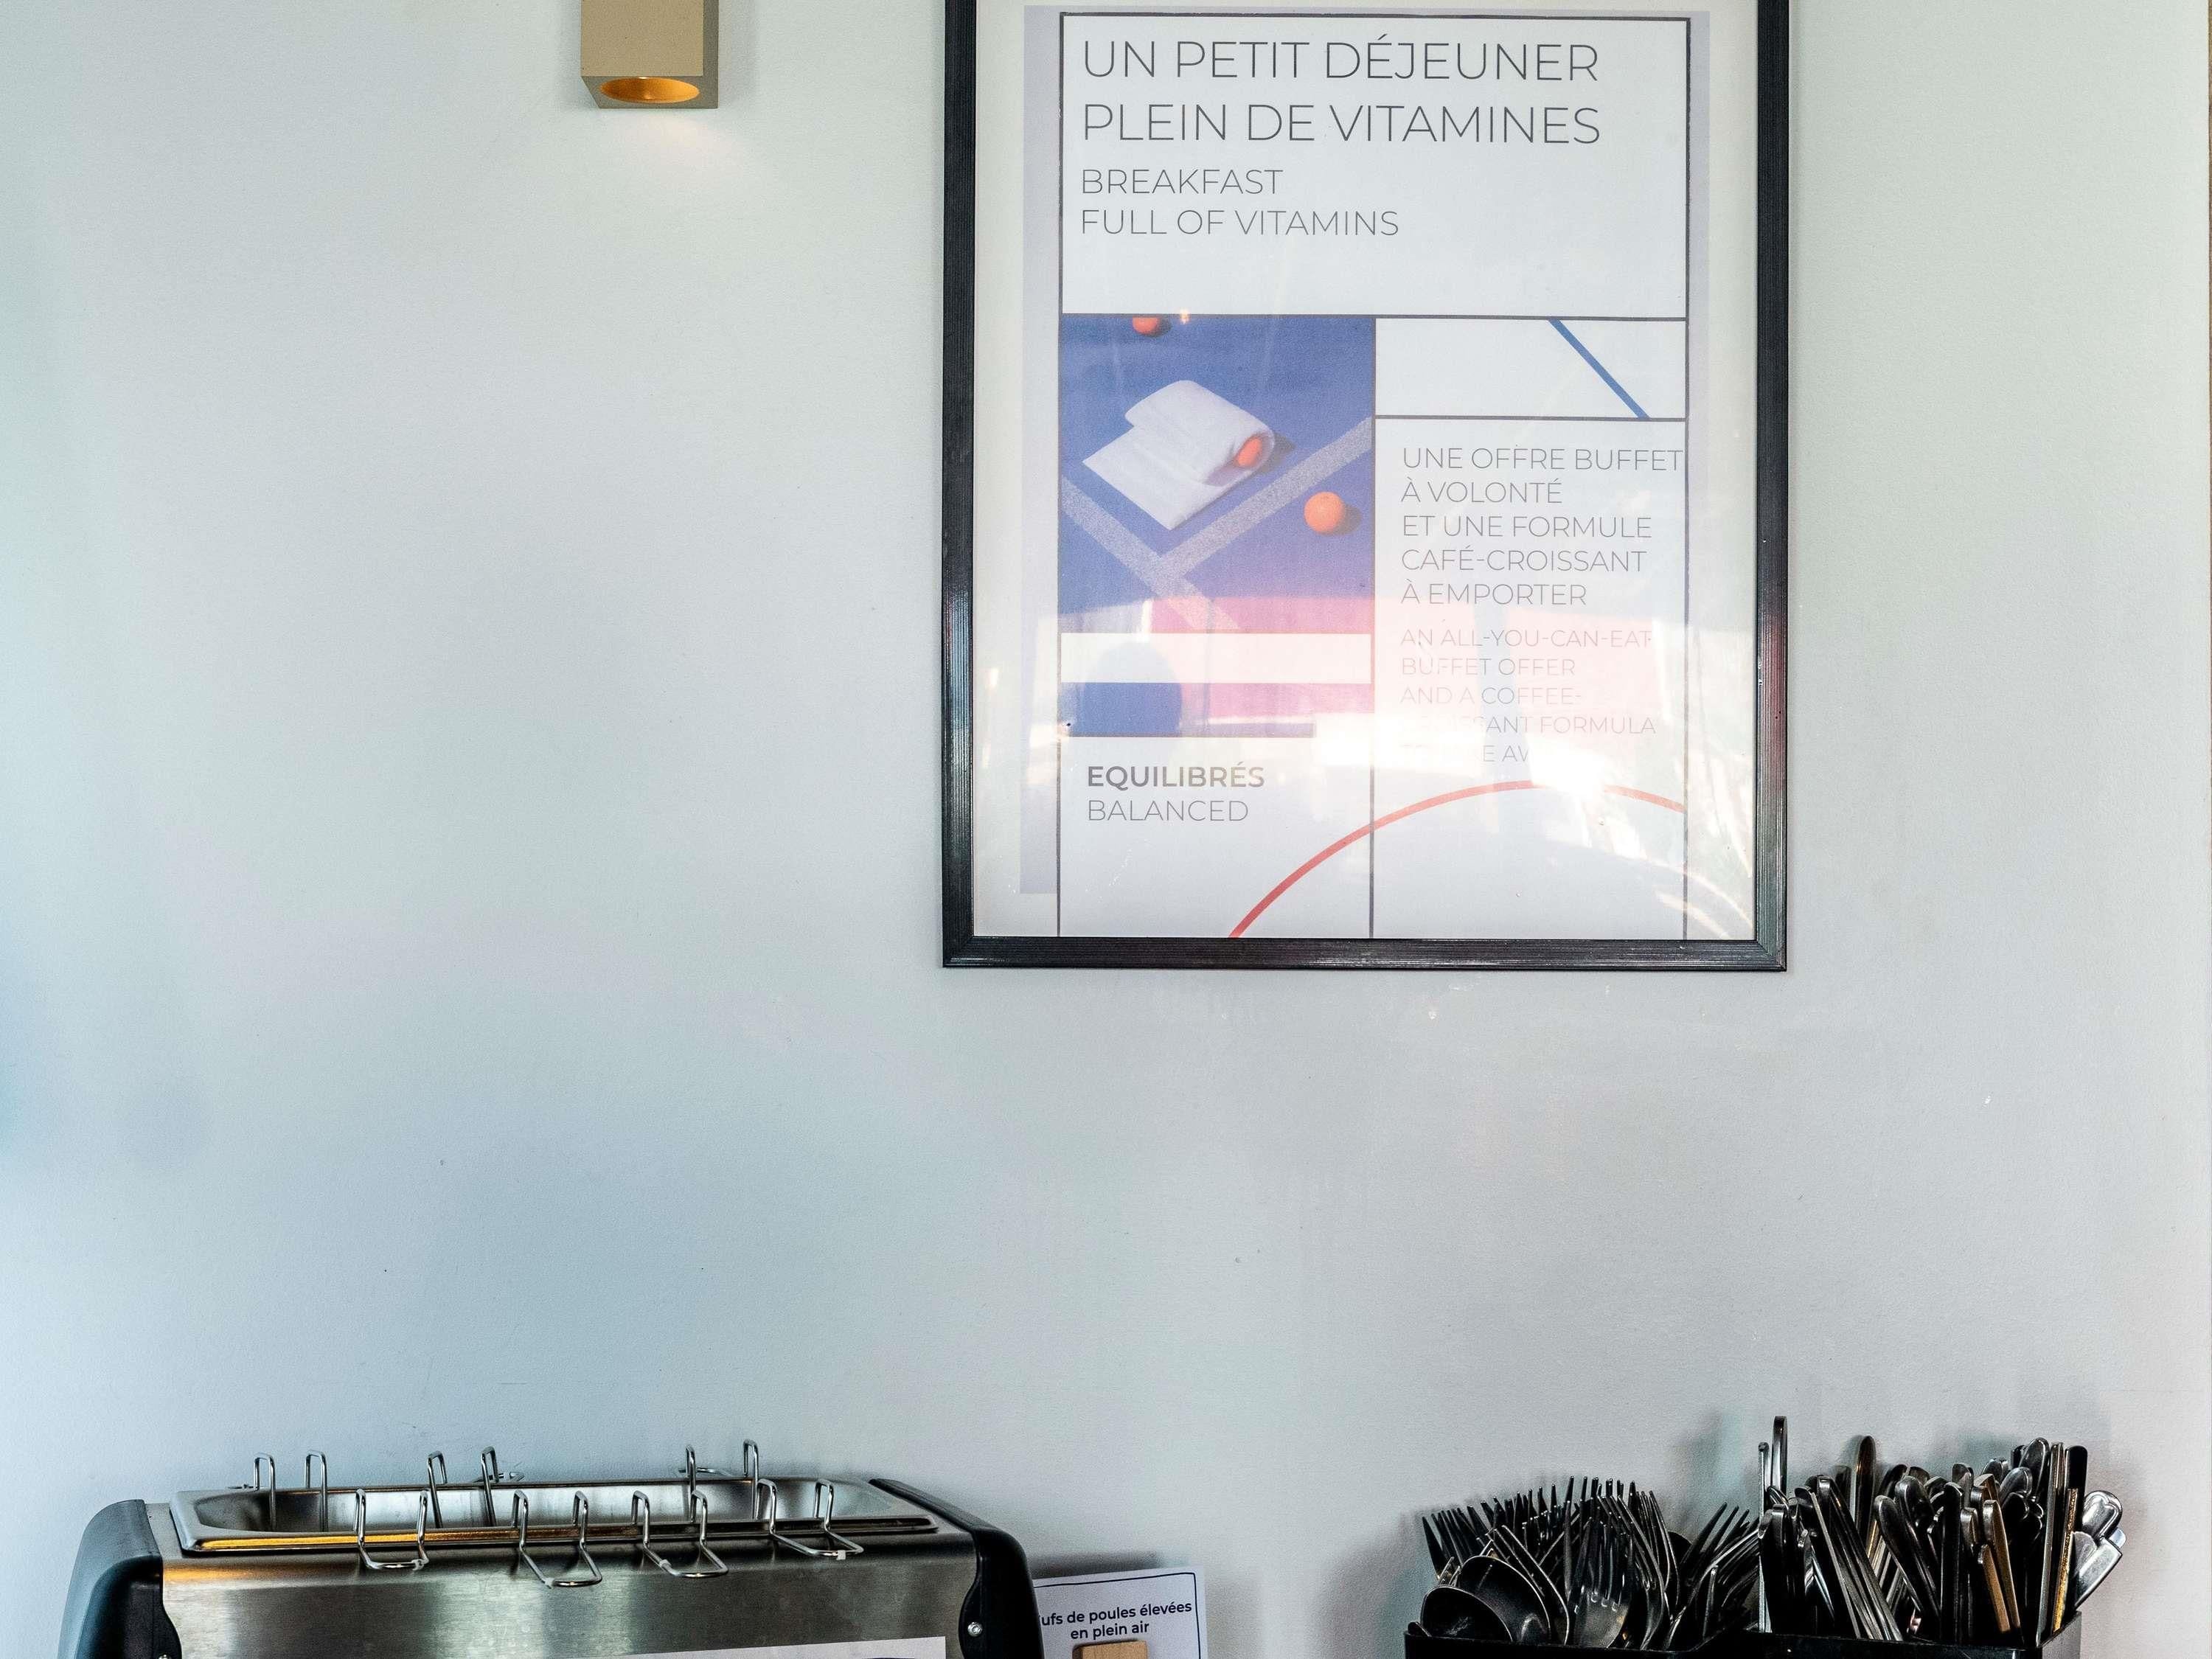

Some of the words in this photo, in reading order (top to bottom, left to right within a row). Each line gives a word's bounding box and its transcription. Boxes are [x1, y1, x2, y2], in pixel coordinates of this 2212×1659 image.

[1085, 41, 1155, 77] UN
[1178, 41, 1310, 78] PETIT
[1326, 34, 1597, 81] DÉJEUNER
[1085, 104, 1225, 140] PLEIN
[1248, 104, 1315, 141] DE
[1329, 105, 1599, 144] VITAMINES
[1082, 169, 1283, 194] BREAKFAST
[1082, 209, 1167, 234] FULL
[1177, 209, 1224, 234] OF
[1235, 210, 1399, 236] VITAMINS
[1404, 448, 1463, 468] UNE
[1472, 448, 1565, 470] OFFRE
[1576, 449, 1683, 470] BUFFET
[1401, 476, 1421, 502] À
[1427, 478, 1562, 504] VOLONTÉ
[1404, 515, 1435, 536] ET
[1444, 516, 1503, 537] UNE
[1513, 516, 1652, 538] FORMULE
[1402, 545, 1646, 571] CAFÉ-CROISSANT
[1401, 579, 1420, 604] À
[1429, 583, 1586, 605] EMPORTER
[1400, 629, 1433, 647] AN
[1402, 658, 1492, 675] BUFFET
[1498, 658, 1575, 675] OFFER
[1400, 686, 1453, 704] AND
[1458, 686, 1475, 704] A
[1481, 686, 1581, 704] COFFEE-
[1540, 716, 1658, 734] FORMULA
[1088, 762, 1264, 791] EQUILIBRÉS
[1088, 800, 1248, 821] BALANCED
[1039, 1614, 1063, 1626] ufs
[1067, 1611, 1085, 1624] de
[1089, 1607, 1136, 1624] poules
[1140, 1601, 1192, 1616] élevées
[1071, 1630, 1088, 1639] en
[1093, 1623, 1127, 1641] plein
[1132, 1621, 1149, 1633] air
